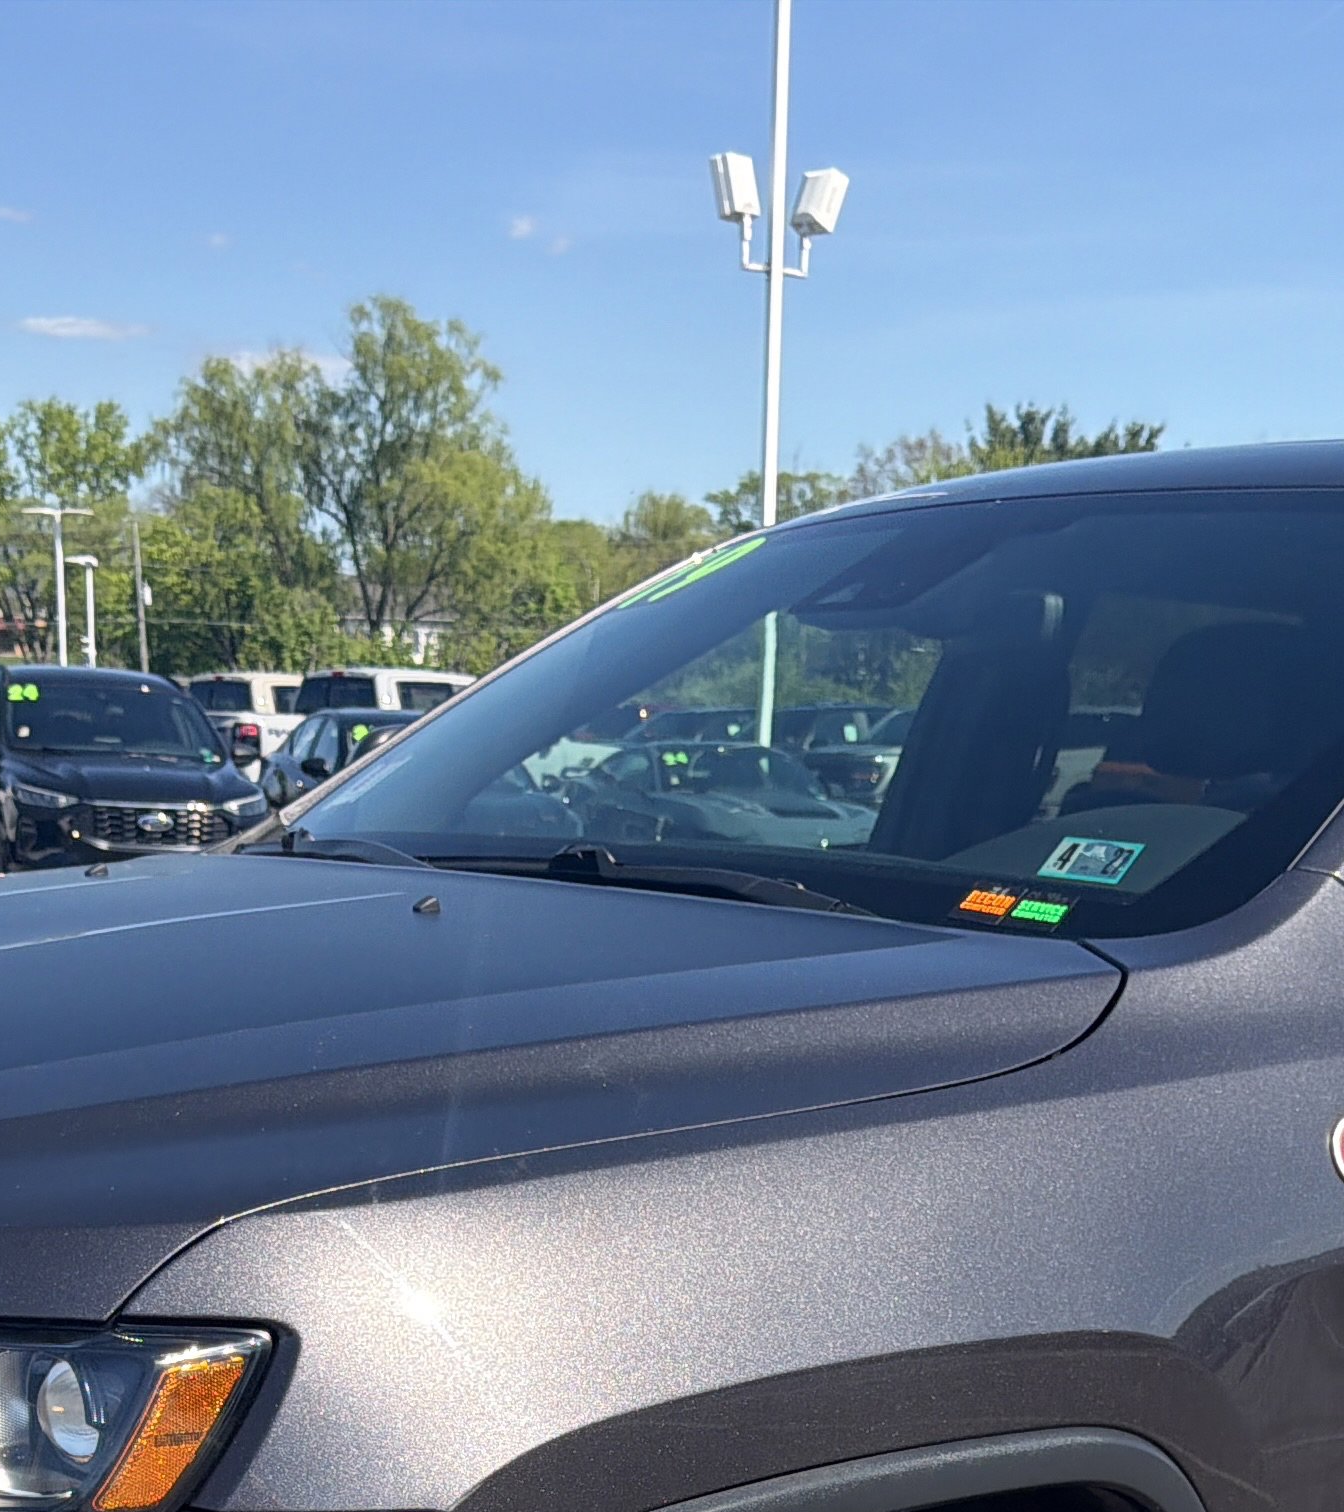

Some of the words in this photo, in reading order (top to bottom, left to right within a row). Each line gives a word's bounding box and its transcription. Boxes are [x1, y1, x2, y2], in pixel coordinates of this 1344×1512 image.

[6, 683, 40, 702] 24
[1056, 843, 1080, 871] 4
[966, 889, 1017, 909] RECON
[1017, 899, 1070, 917] SERVICE
